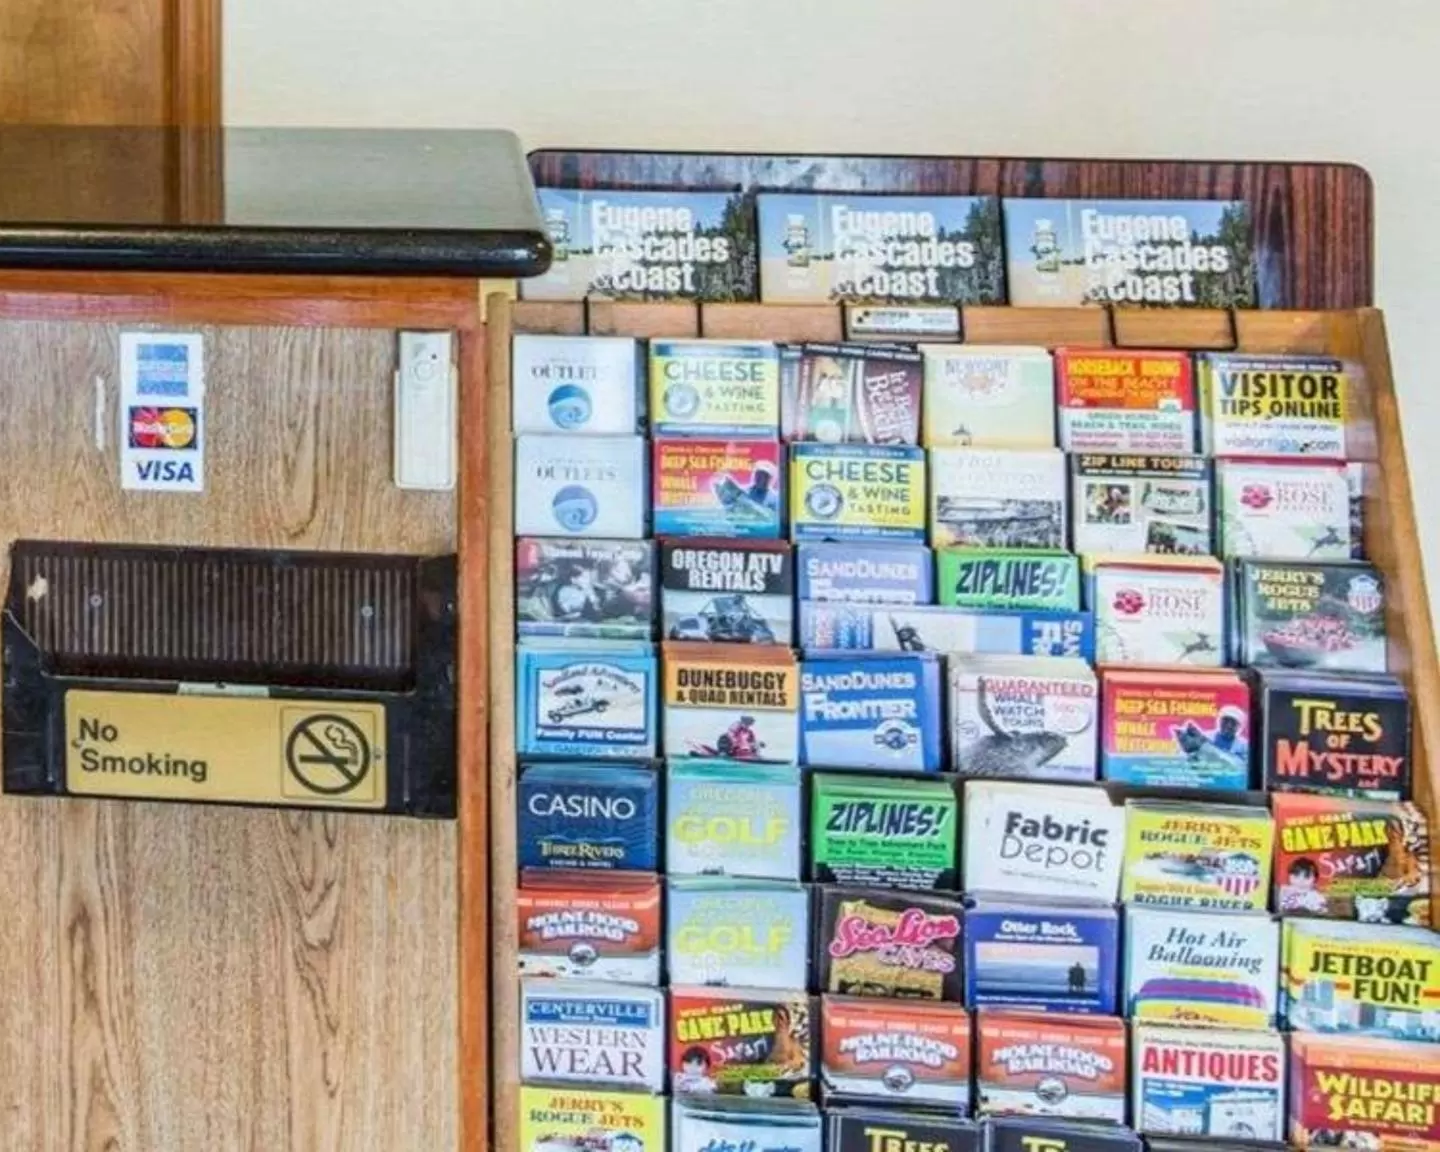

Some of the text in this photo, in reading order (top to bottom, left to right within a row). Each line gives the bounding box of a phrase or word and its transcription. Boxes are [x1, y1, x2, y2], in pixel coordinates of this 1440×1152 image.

[592, 199, 692, 236] Eugene
[831, 205, 935, 241] Eugene
[1081, 208, 1188, 244] Eugene
[593, 232, 730, 262] Cascades
[833, 235, 975, 267] Cascades
[1083, 240, 1229, 273] Cascades
[664, 360, 765, 383] CHEESE
[718, 386, 765, 398] WINE
[1220, 373, 1338, 399] VISITOR
[707, 402, 765, 413] TASTING
[1221, 399, 1341, 418] TIPS ONLINE
[136, 459, 195, 483] VISA
[806, 460, 910, 484] CHEESE
[1082, 456, 1108, 467] ZIP
[1150, 457, 1205, 470] TOURS
[847, 487, 911, 502] & WINE
[1277, 489, 1329, 502] ROSE
[849, 504, 911, 516] TASTING
[671, 549, 783, 574] OREGON ATV
[688, 569, 767, 592] RENTALS
[956, 560, 1071, 598] ZIPLINES!
[1251, 568, 1325, 584] JERRY'S
[1149, 594, 1203, 611] ROSE
[1257, 583, 1320, 598] ROGUE
[677, 668, 787, 690] DUNEBUGGY
[801, 672, 916, 691] SANDDUNES
[985, 678, 1094, 697] GUARANTEED
[688, 690, 727, 704] QUAD
[730, 691, 786, 707] RENTALS
[804, 693, 917, 721] FRONTIER
[1116, 698, 1218, 717] DEEP SEA FISHING
[994, 706, 1045, 717] WATCH
[1292, 699, 1383, 742] TREES
[77, 719, 119, 744] No
[1326, 734, 1350, 748] OF
[80, 749, 208, 783] Smoking
[1276, 739, 1404, 785] MYSTERY
[529, 793, 636, 820] CASINO
[674, 817, 790, 845] GOLF
[826, 801, 950, 837] ZIPLINES!
[1005, 811, 1109, 848] Fabric
[1160, 819, 1242, 835] JERRY'S
[1140, 830, 1262, 849] ROGUE JETS
[1281, 819, 1389, 853] GAME PARK
[1000, 833, 1107, 873] Depot
[1319, 849, 1381, 878] Safari
[1134, 892, 1254, 911] ROGUE RIVER
[542, 923, 625, 942] RAILROAD
[588, 911, 639, 933] HOOD
[1001, 919, 1078, 938] Otter Rock
[675, 926, 793, 955] GOLF
[829, 914, 891, 957] Sea
[1167, 926, 1247, 949] Hot Air
[1148, 944, 1263, 975] Ballooning
[1309, 950, 1433, 982] JETBOAT
[1353, 978, 1422, 1005] FUN!
[528, 1002, 647, 1019] CENTERVILLE
[529, 1026, 647, 1048] WESTERN
[676, 1009, 775, 1042] GAME PARK
[532, 1047, 647, 1078] WEAR
[711, 1037, 768, 1064] Safari
[856, 1045, 943, 1068] RAILROAD
[1008, 1058, 1098, 1080] RAILROAD
[1142, 1046, 1279, 1083] ANTIQUES
[548, 1096, 625, 1113] JERRY'S
[1327, 1093, 1435, 1126] SAFARI
[530, 1111, 645, 1128] ROGUE JETS
